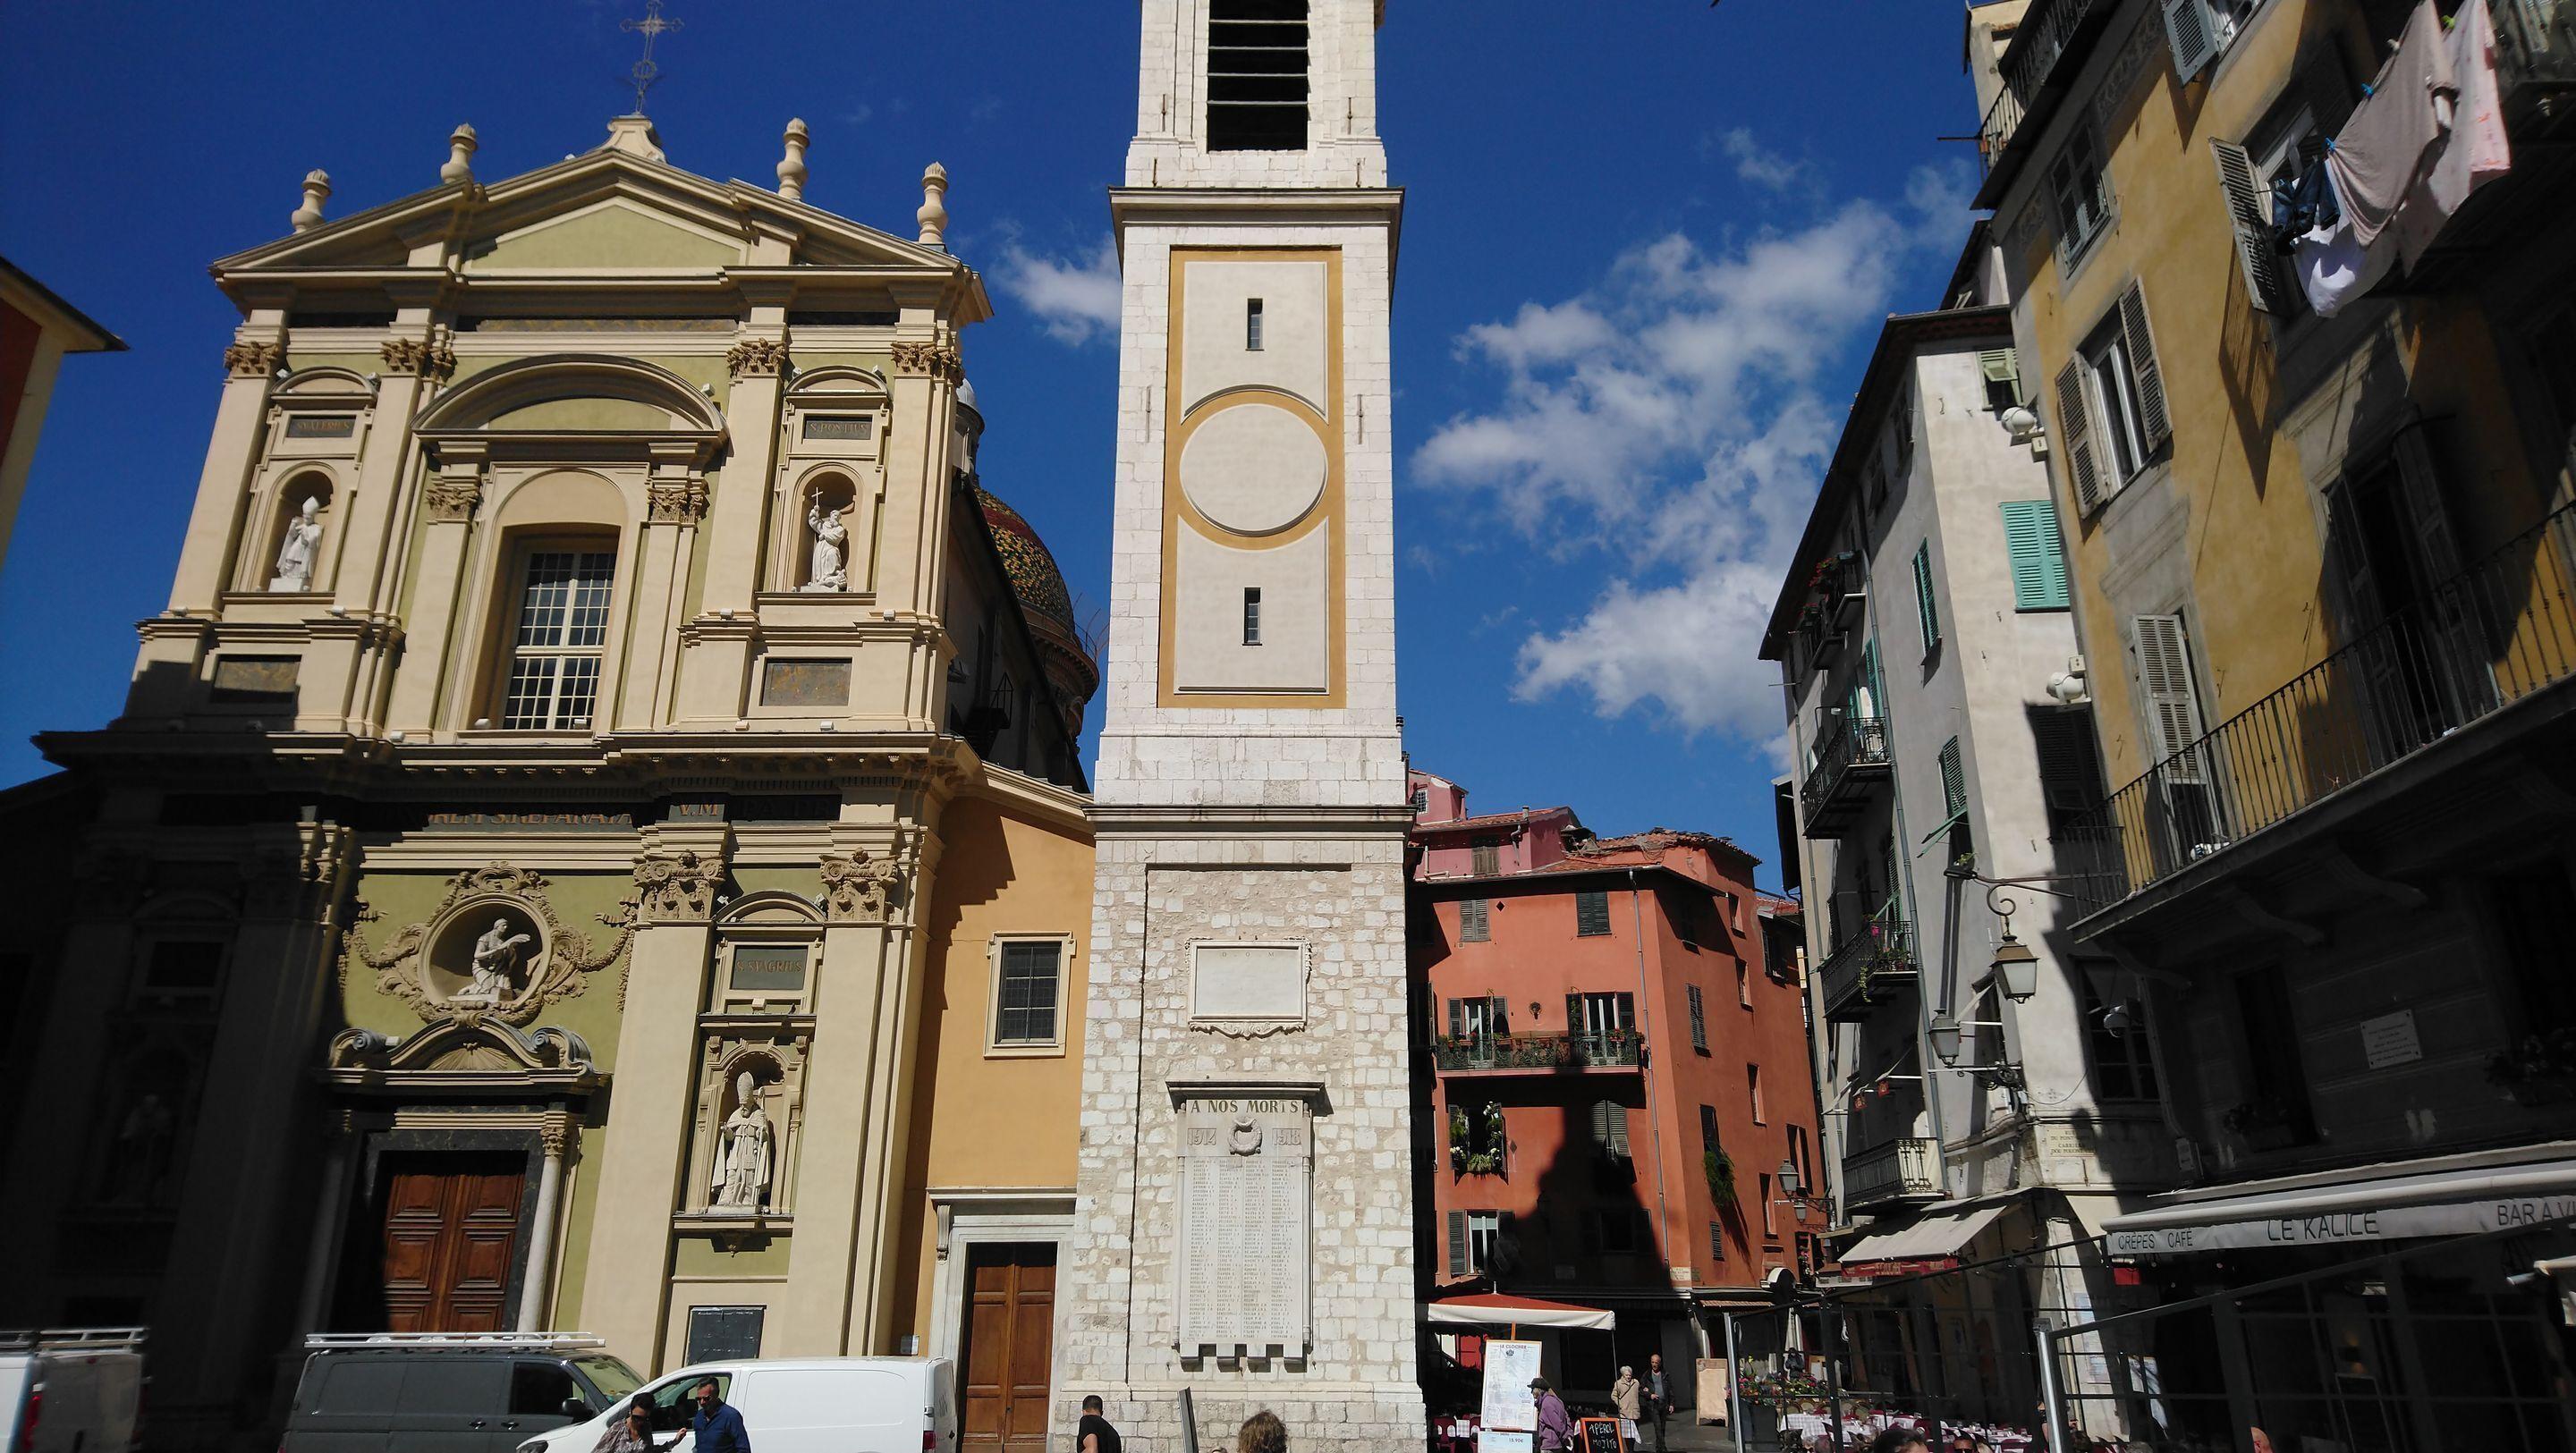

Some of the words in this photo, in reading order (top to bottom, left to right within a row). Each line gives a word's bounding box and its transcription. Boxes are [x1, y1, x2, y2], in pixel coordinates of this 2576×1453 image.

[1208, 1101, 1238, 1113] NOS
[1246, 1100, 1299, 1113] MORTS
[2267, 1220, 2294, 1241] LE
[2303, 1212, 2379, 1240] KALICE
[2497, 1203, 2537, 1226] BAR
[1592, 1438, 1617, 1449] MOJITO
